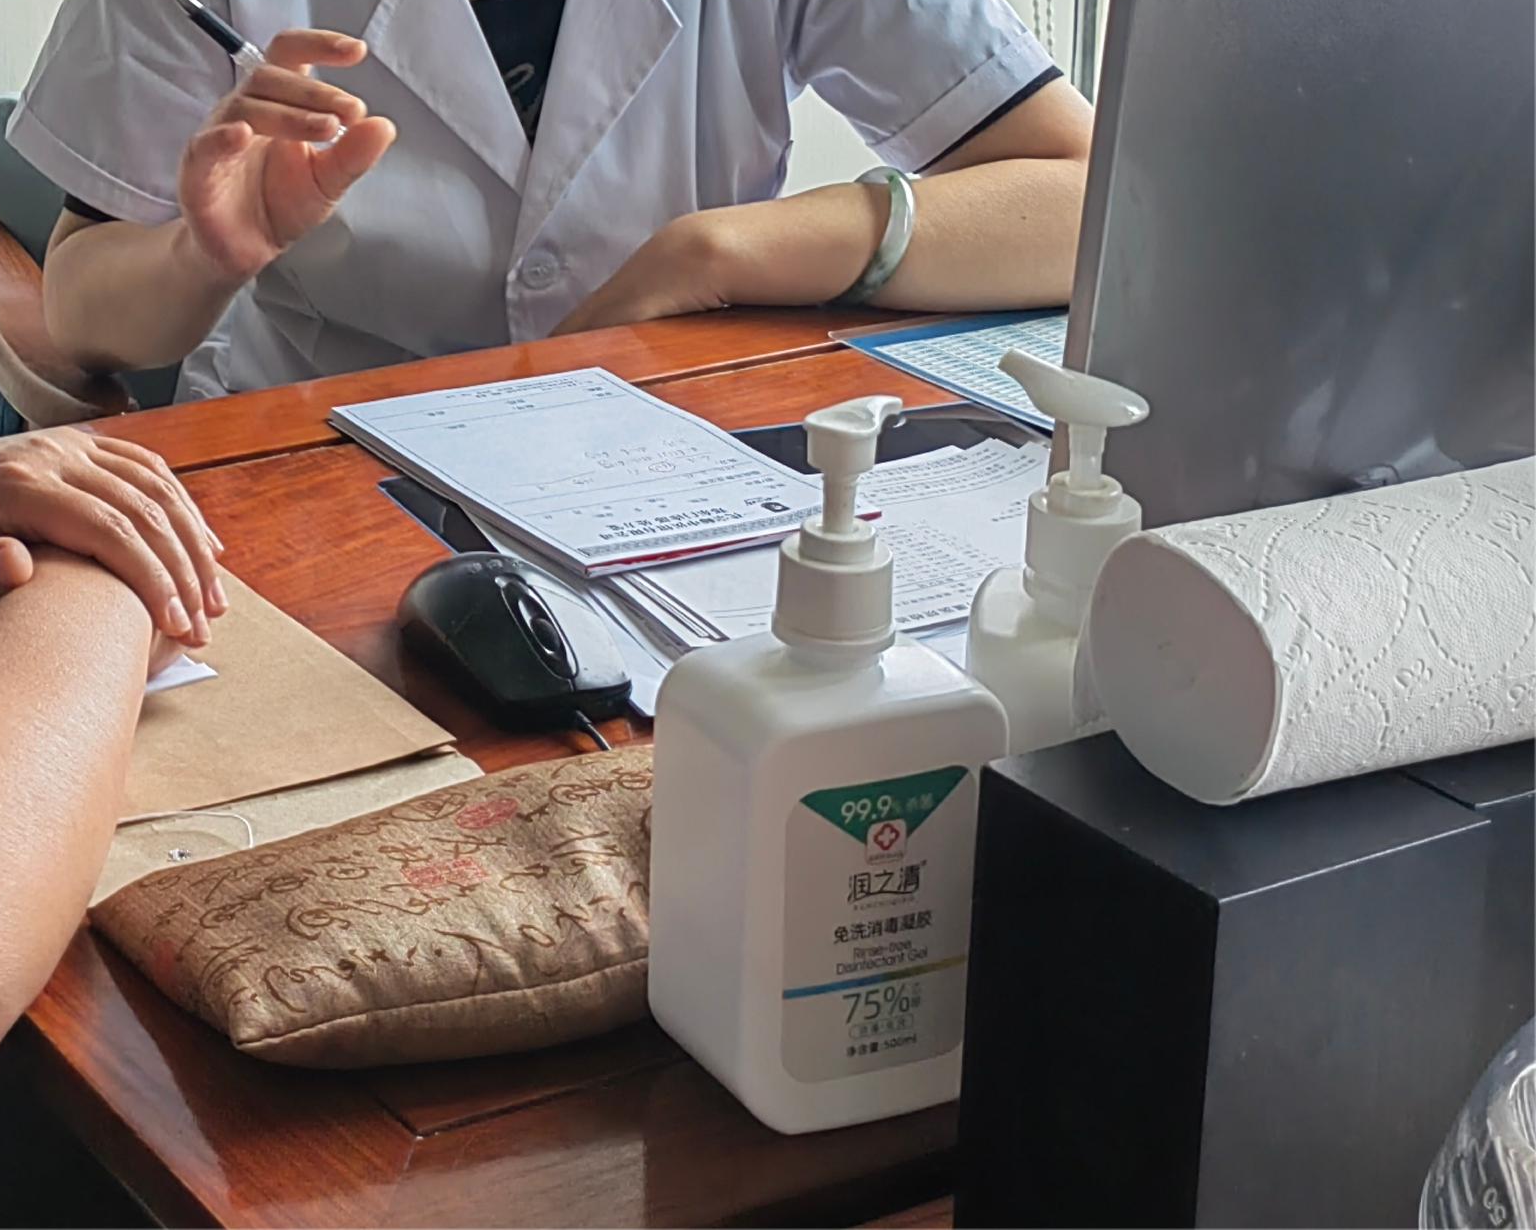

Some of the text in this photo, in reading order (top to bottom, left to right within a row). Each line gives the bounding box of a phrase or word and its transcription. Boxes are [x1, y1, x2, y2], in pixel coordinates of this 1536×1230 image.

[833, 910, 932, 944] 免洗消毒凝胶
[842, 984, 910, 1024] 75%
